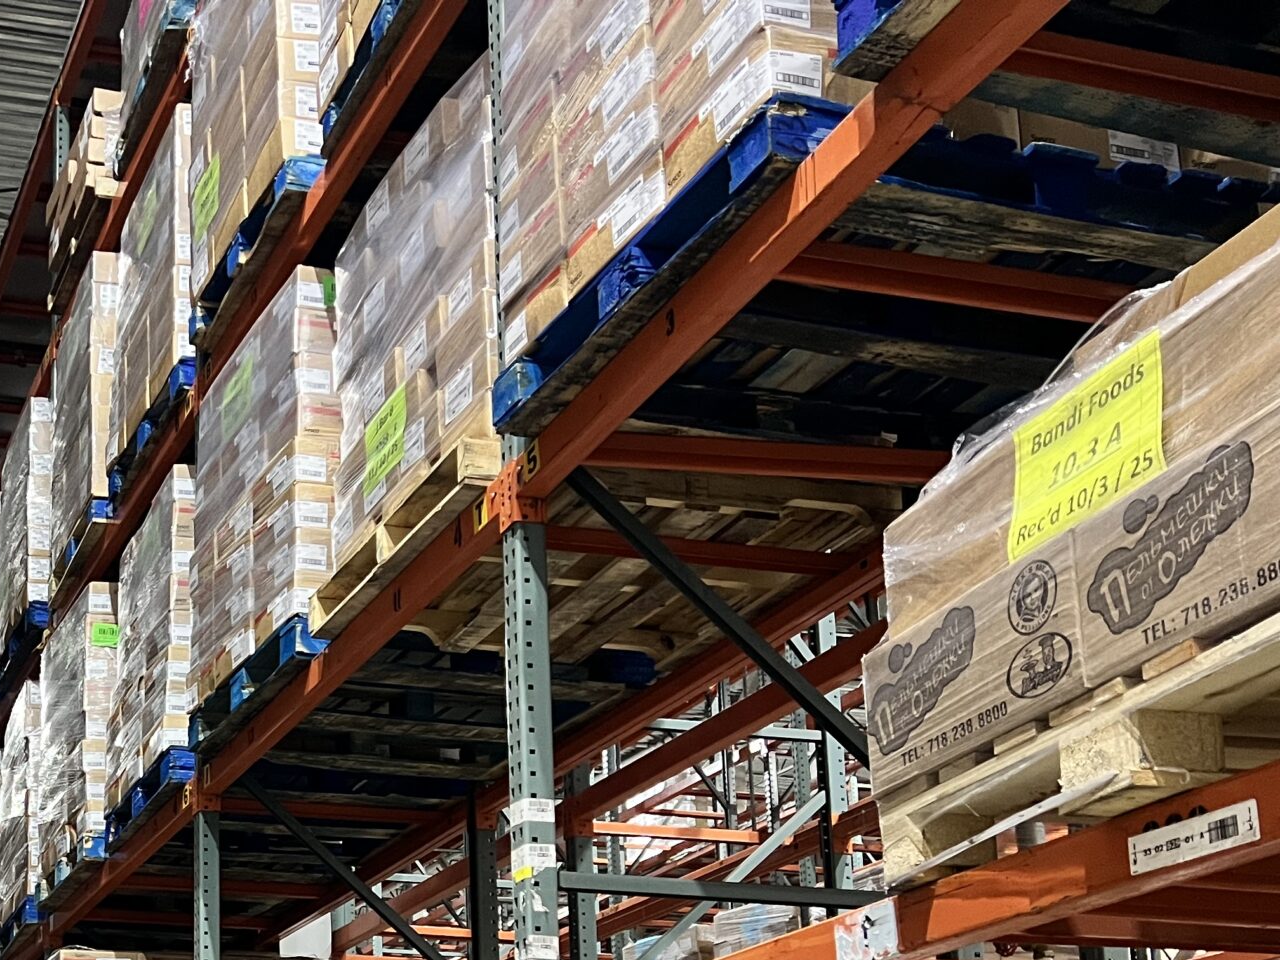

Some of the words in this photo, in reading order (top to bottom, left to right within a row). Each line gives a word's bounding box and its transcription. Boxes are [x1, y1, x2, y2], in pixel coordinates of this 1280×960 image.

[1031, 401, 1083, 456] Bandi
[1088, 362, 1145, 417] Foods
[525, 445, 538, 475] 5
[1048, 435, 1099, 490] 10.3
[1105, 421, 1121, 449] A
[1016, 502, 1062, 546] Rec'd
[1130, 448, 1153, 480] 25
[1141, 619, 1177, 645] TEL:
[1181, 560, 1280, 626] 718.238.88
[901, 753, 926, 767] TEL:
[927, 700, 1008, 754] 718.238.8800
